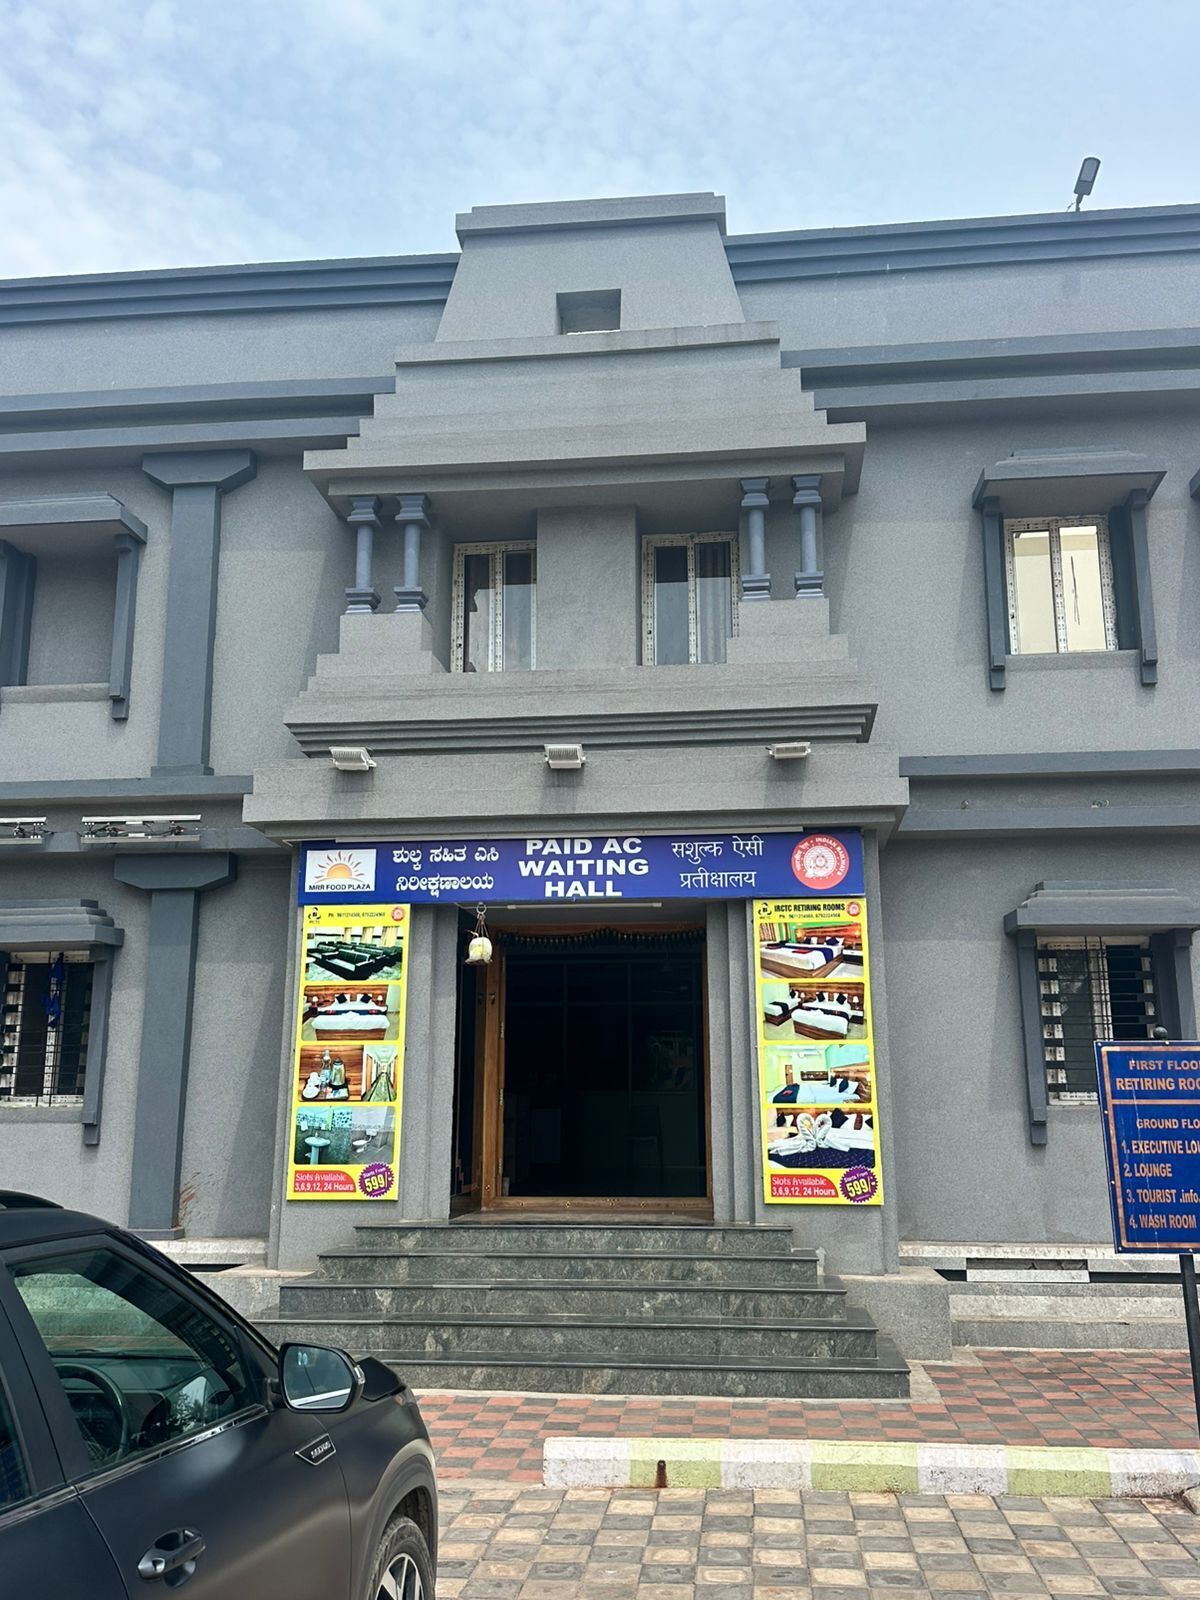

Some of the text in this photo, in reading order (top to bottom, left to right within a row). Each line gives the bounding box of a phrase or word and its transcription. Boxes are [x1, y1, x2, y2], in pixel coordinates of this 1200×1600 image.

[526, 837, 642, 856] PAID AC
[671, 835, 764, 864] सशुल्क ऐसी
[815, 837, 837, 848] INDIAN
[392, 845, 500, 870] ಶುಲ್ಕ ಸಹಿತ ಎಸಿ
[518, 859, 649, 876] WAITING
[396, 872, 494, 898] ನಿರೀಕ್ಷಣಾಲಯ
[680, 867, 757, 888] प्रतीक्षालय
[544, 880, 622, 898] HALL
[774, 903, 846, 912] IRCTC RETIRING ROOMS
[1129, 1060, 1200, 1070] FIRST FLOO
[1116, 1078, 1175, 1091] RETIRING
[1136, 1118, 1179, 1129] GROUND
[1121, 1140, 1130, 1154] 1.
[1131, 1140, 1183, 1154] EXECUTIVE
[1124, 1163, 1172, 1178] 2. LOUNGE
[324, 1182, 332, 1190] 24
[333, 1182, 354, 1191] Hours
[772, 1177, 826, 1186] Slots Available
[803, 1187, 812, 1195] 24
[813, 1187, 836, 1196] Hours
[1126, 1189, 1135, 1204] 3.
[1136, 1189, 1177, 1204] TOURIST
[1129, 1214, 1197, 1229] 4. WASH ROOM
